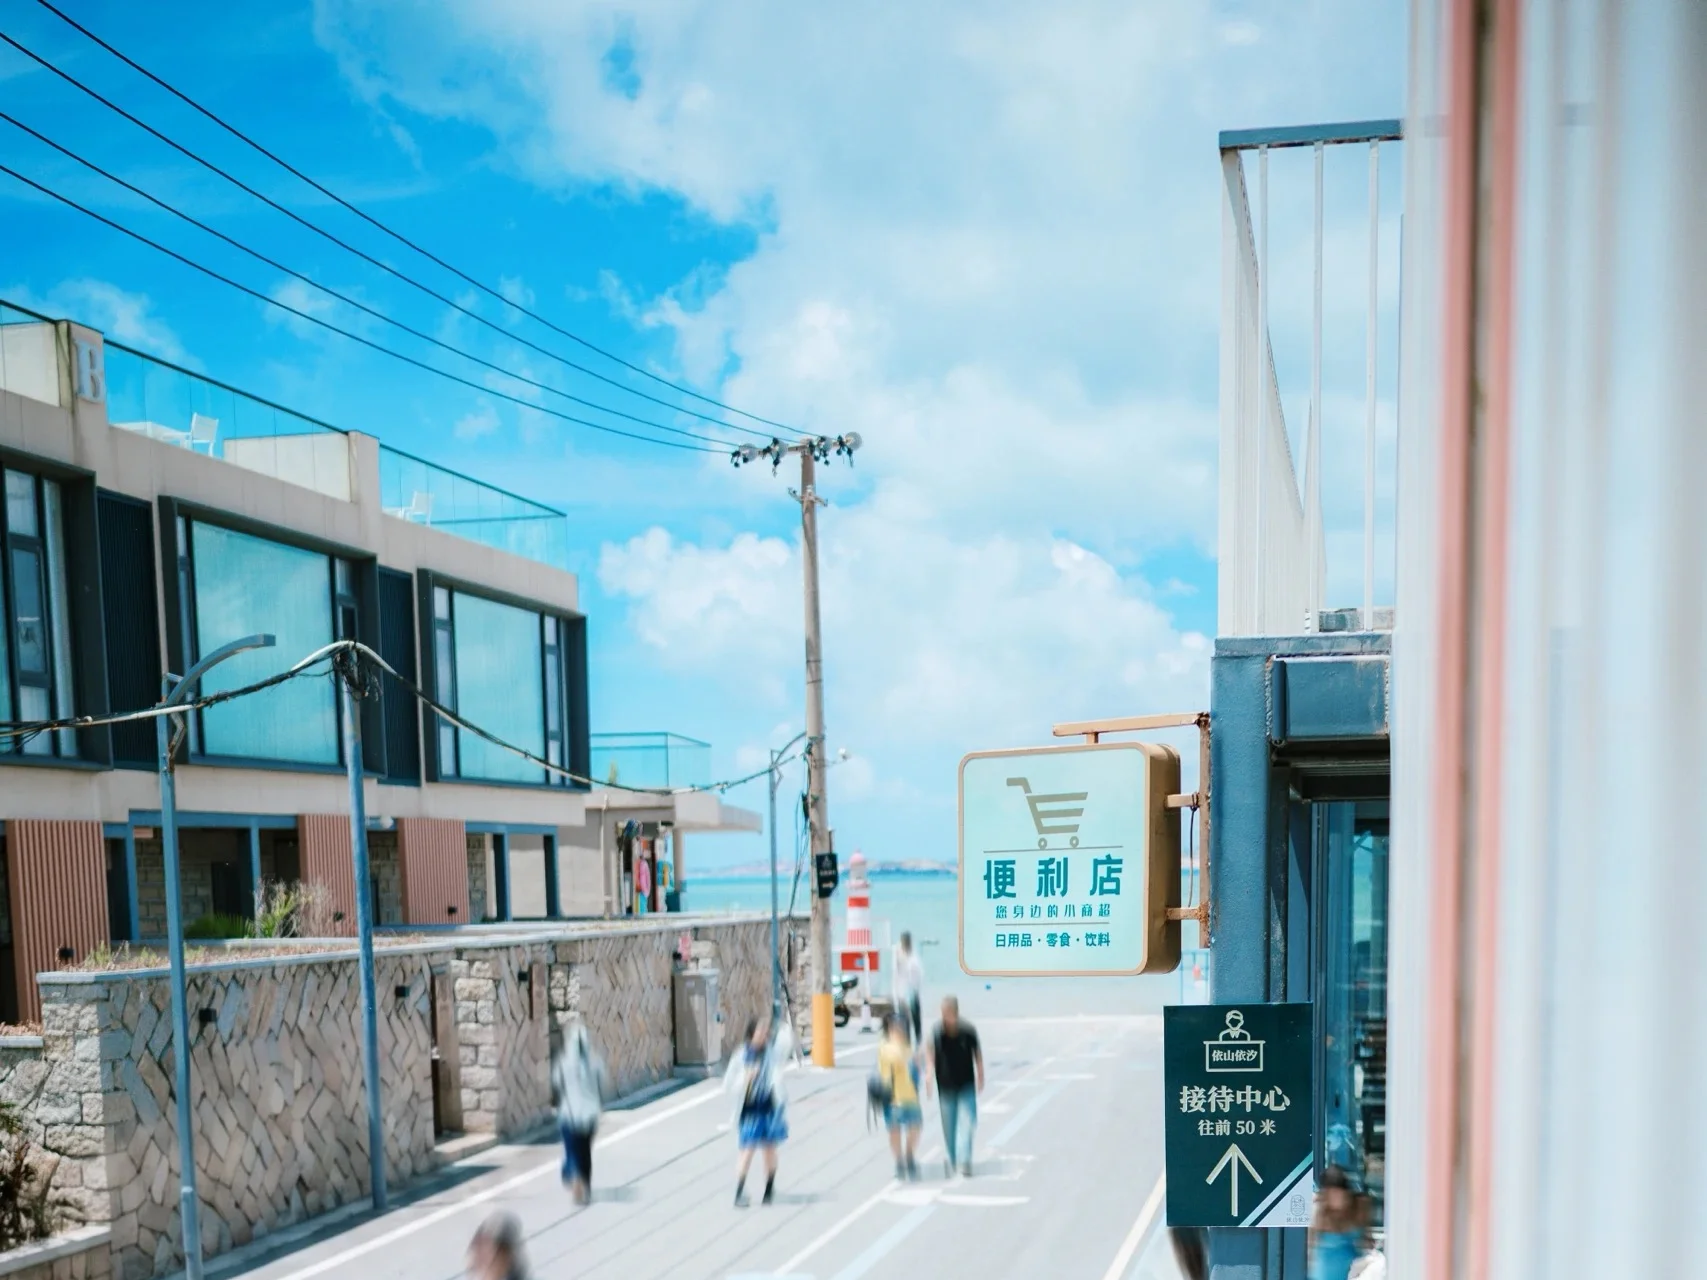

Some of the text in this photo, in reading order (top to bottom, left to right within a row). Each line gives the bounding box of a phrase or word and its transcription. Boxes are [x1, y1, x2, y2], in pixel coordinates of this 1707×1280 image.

[984, 854, 1123, 899] 便利店
[996, 904, 1110, 919] 您身边的小商超
[1212, 1049, 1258, 1062] 依山依汐
[1179, 1085, 1291, 1113] 接待中心
[1197, 1119, 1276, 1136] 往前 50 米
